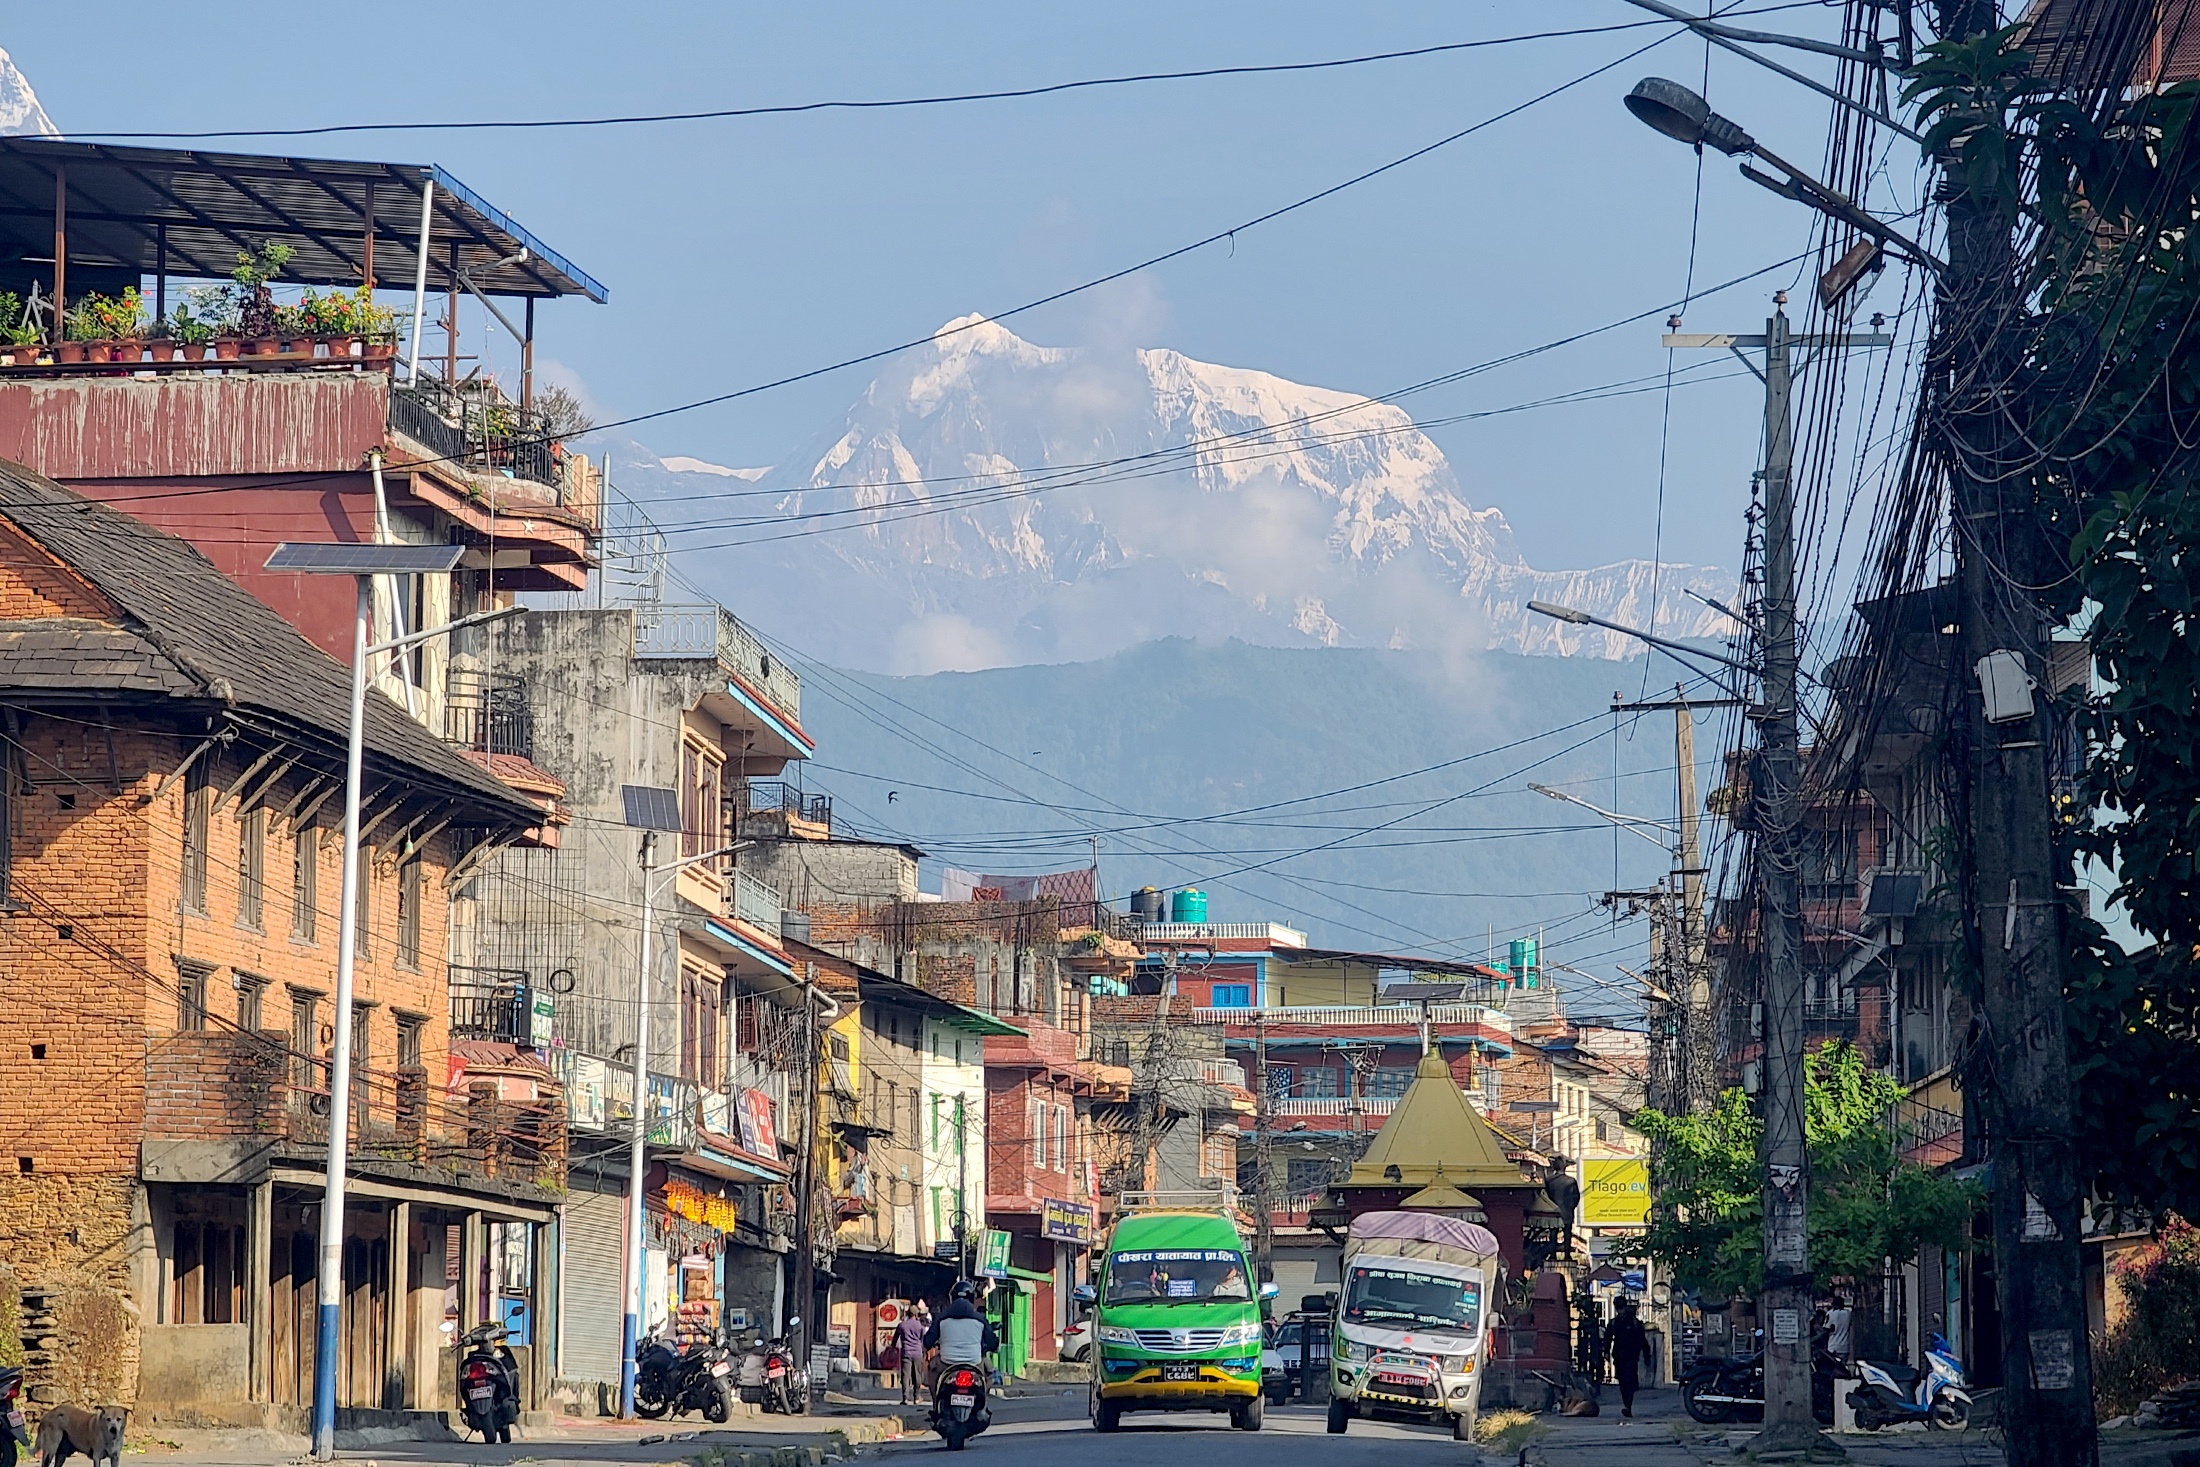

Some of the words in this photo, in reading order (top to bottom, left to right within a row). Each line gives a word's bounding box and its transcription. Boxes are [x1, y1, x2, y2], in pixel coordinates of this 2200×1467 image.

[1588, 1179, 1646, 1195] Tiago.ev
[1118, 1251, 1152, 1262] पोखरा
[1155, 1251, 1202, 1261] यातायात
